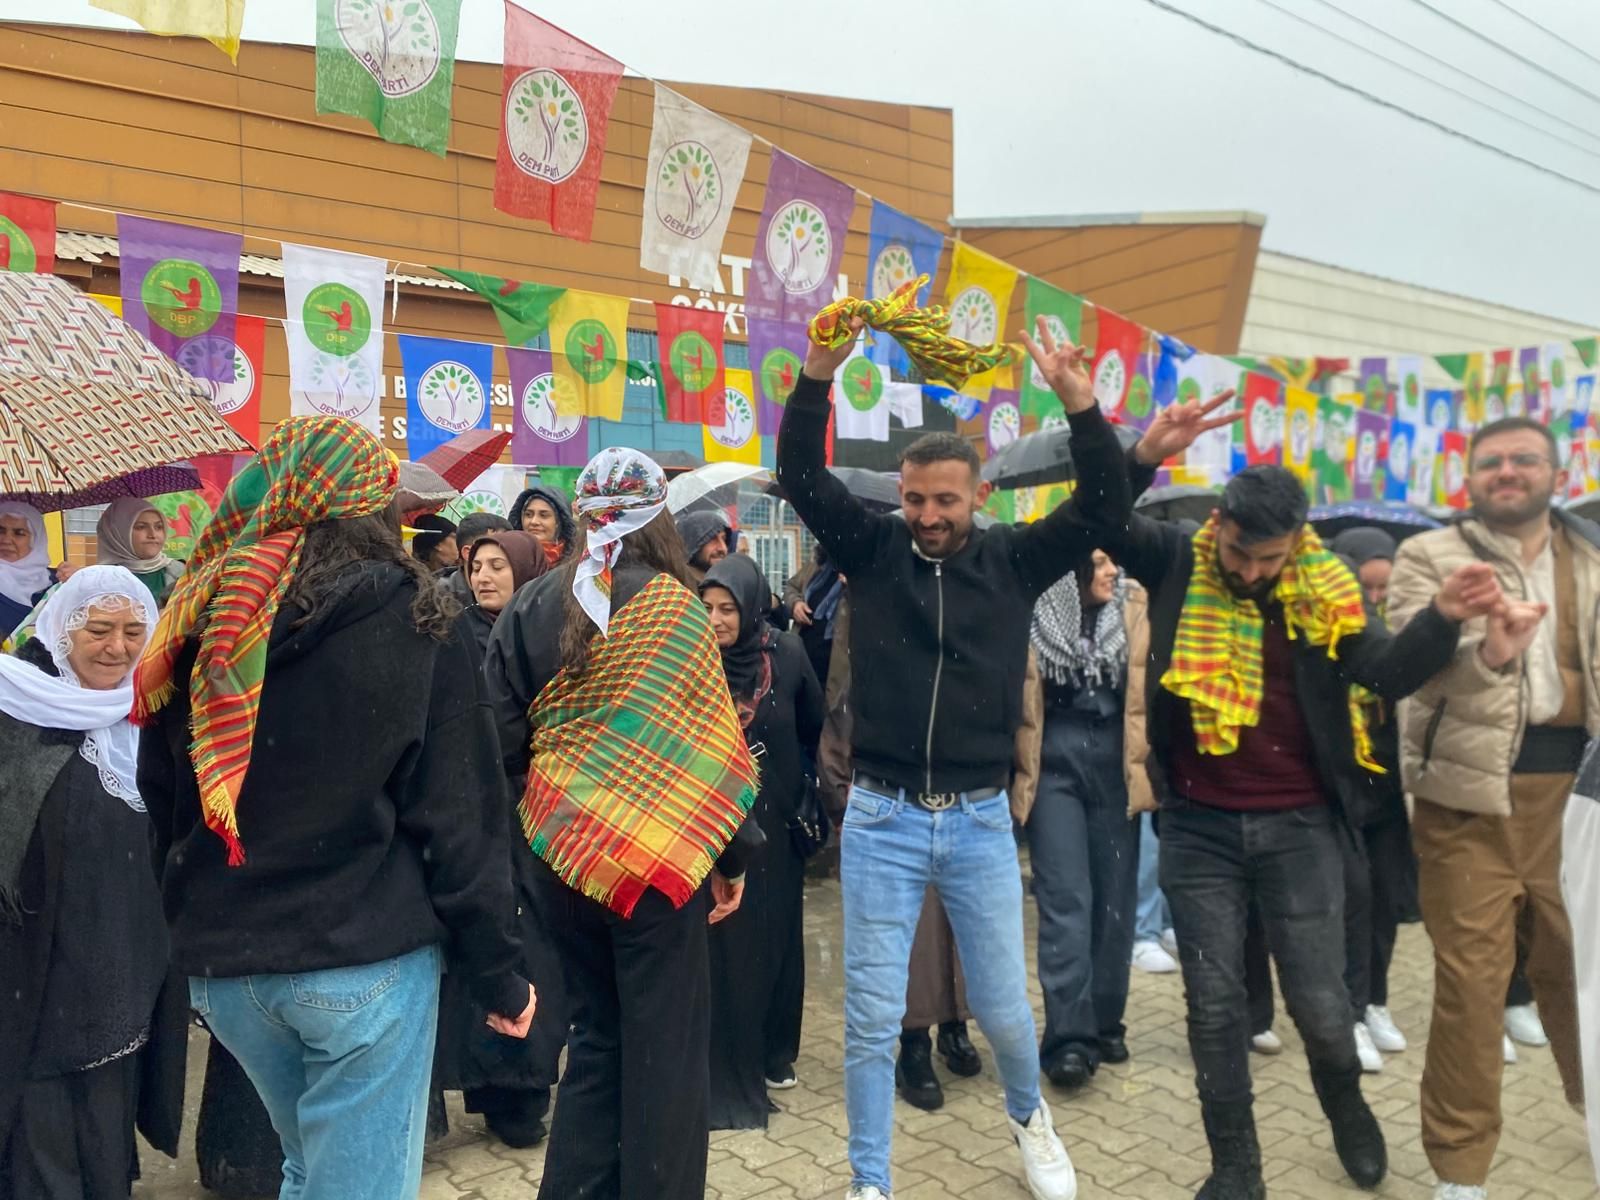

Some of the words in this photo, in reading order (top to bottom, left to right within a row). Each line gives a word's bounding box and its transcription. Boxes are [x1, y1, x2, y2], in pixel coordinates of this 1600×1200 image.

[382, 74, 410, 91] ARTİ
[518, 151, 542, 172] DEM
[664, 214, 686, 232] DEM
